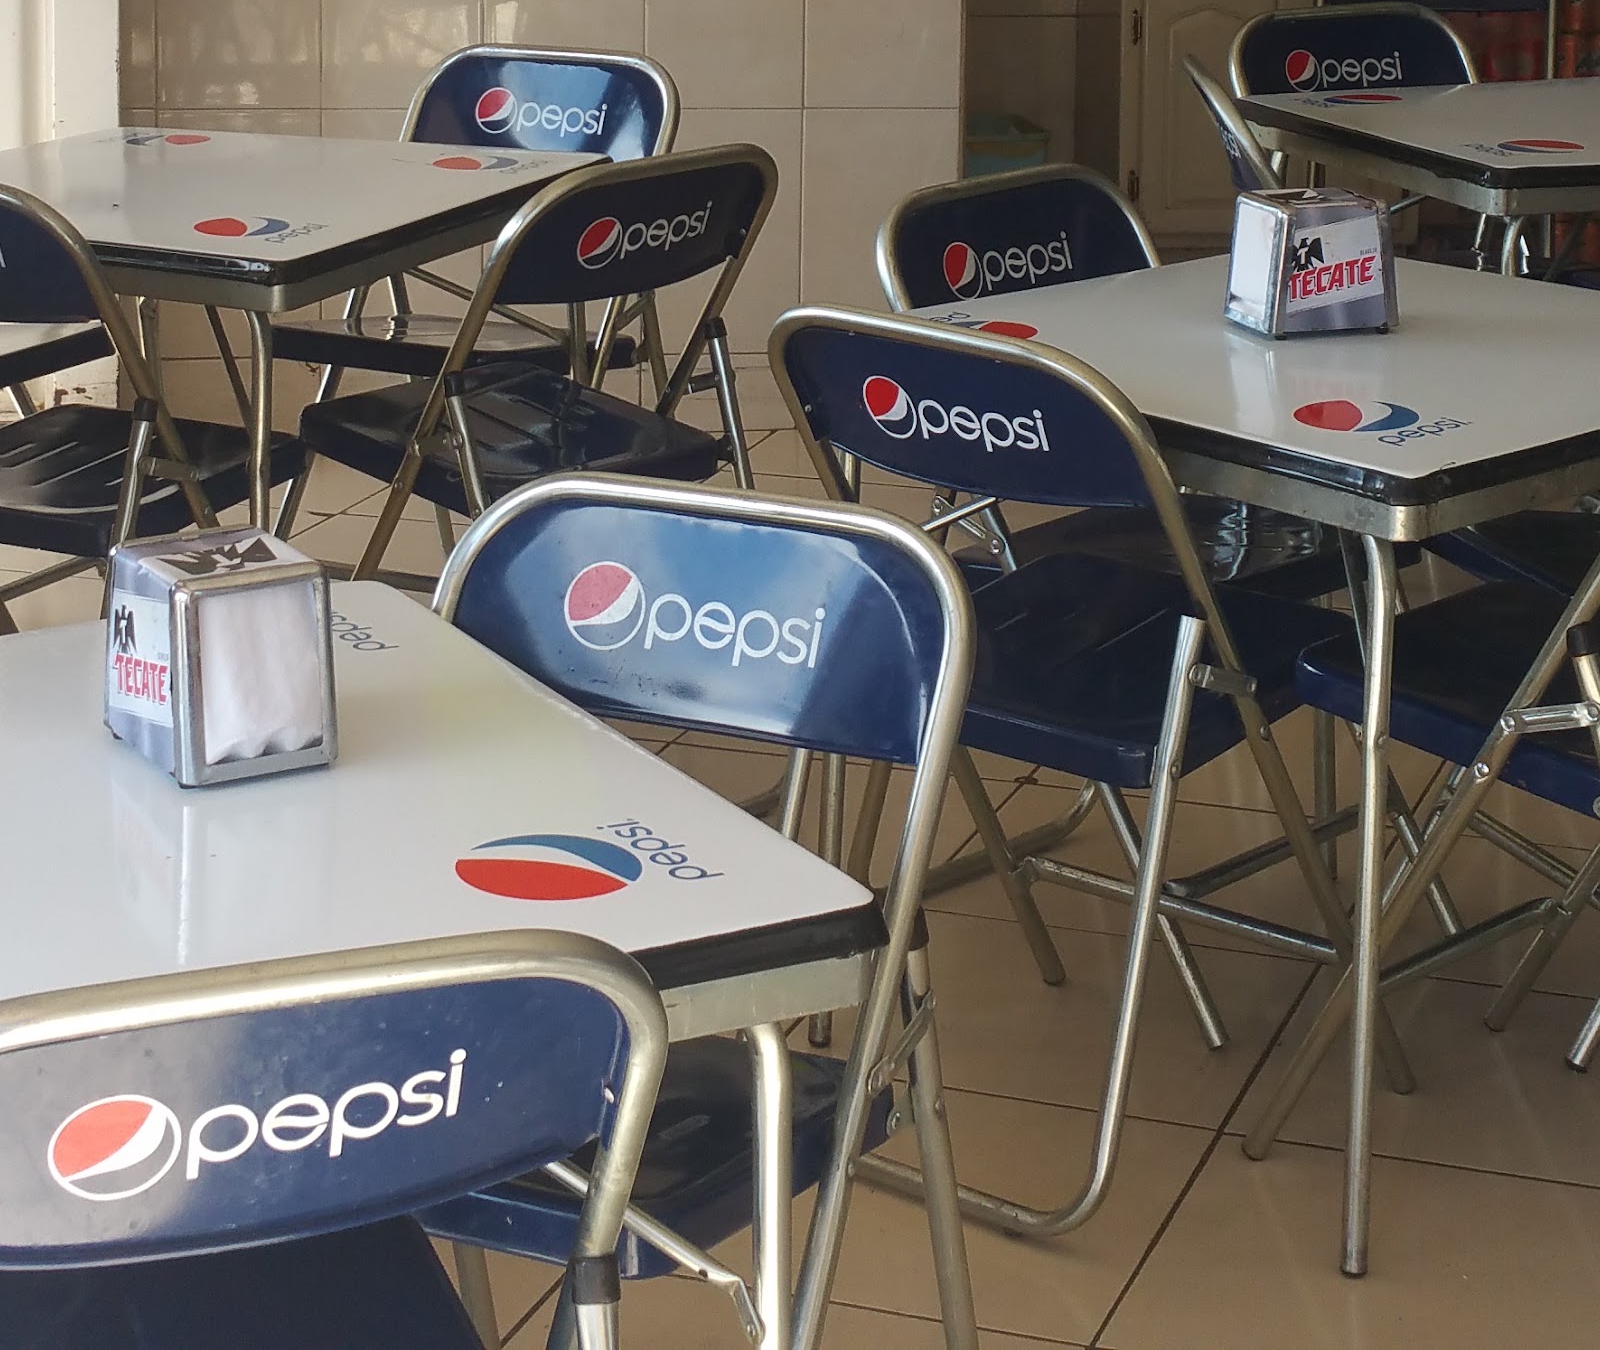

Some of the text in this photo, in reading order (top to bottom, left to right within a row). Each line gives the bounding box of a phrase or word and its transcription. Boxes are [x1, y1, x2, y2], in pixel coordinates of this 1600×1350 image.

[1322, 51, 1403, 89] pepsi
[514, 101, 608, 138] pepsi
[619, 200, 713, 260] pepsi
[982, 230, 1074, 291] pepsi
[1288, 255, 1376, 302] TECATE
[917, 397, 1050, 453] pepsi
[1378, 417, 1471, 447] pepsi
[644, 592, 827, 668] pepsi
[113, 653, 168, 705] TECATE
[605, 817, 725, 881] pepsi
[185, 1048, 467, 1180] pepsi
